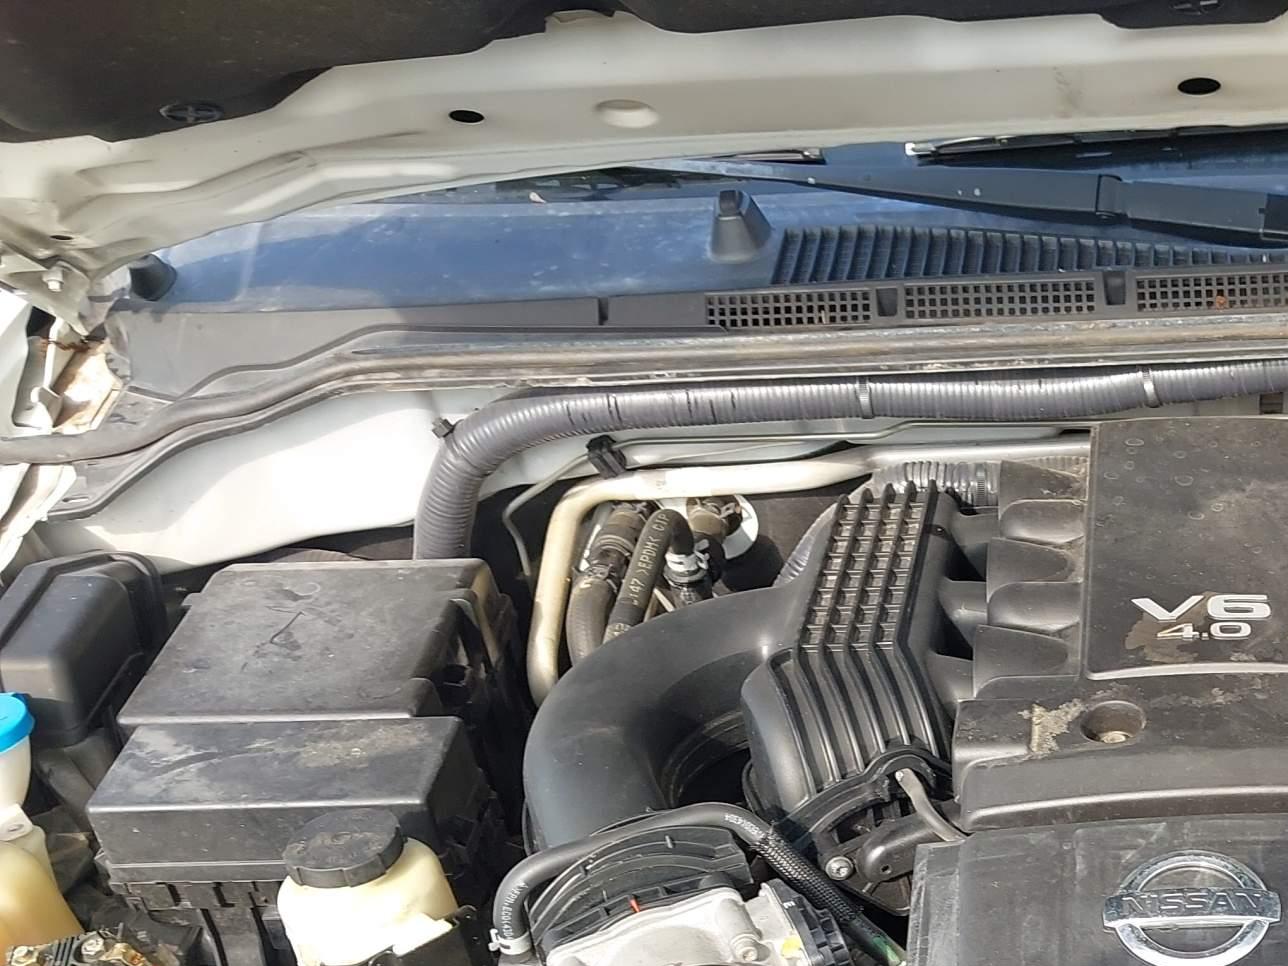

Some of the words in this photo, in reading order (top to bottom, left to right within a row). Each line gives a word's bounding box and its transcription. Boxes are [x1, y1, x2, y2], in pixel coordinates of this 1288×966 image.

[1131, 594, 1272, 622] V6
[1156, 621, 1252, 641] 4.0
[1121, 891, 1261, 915] NISSAN
